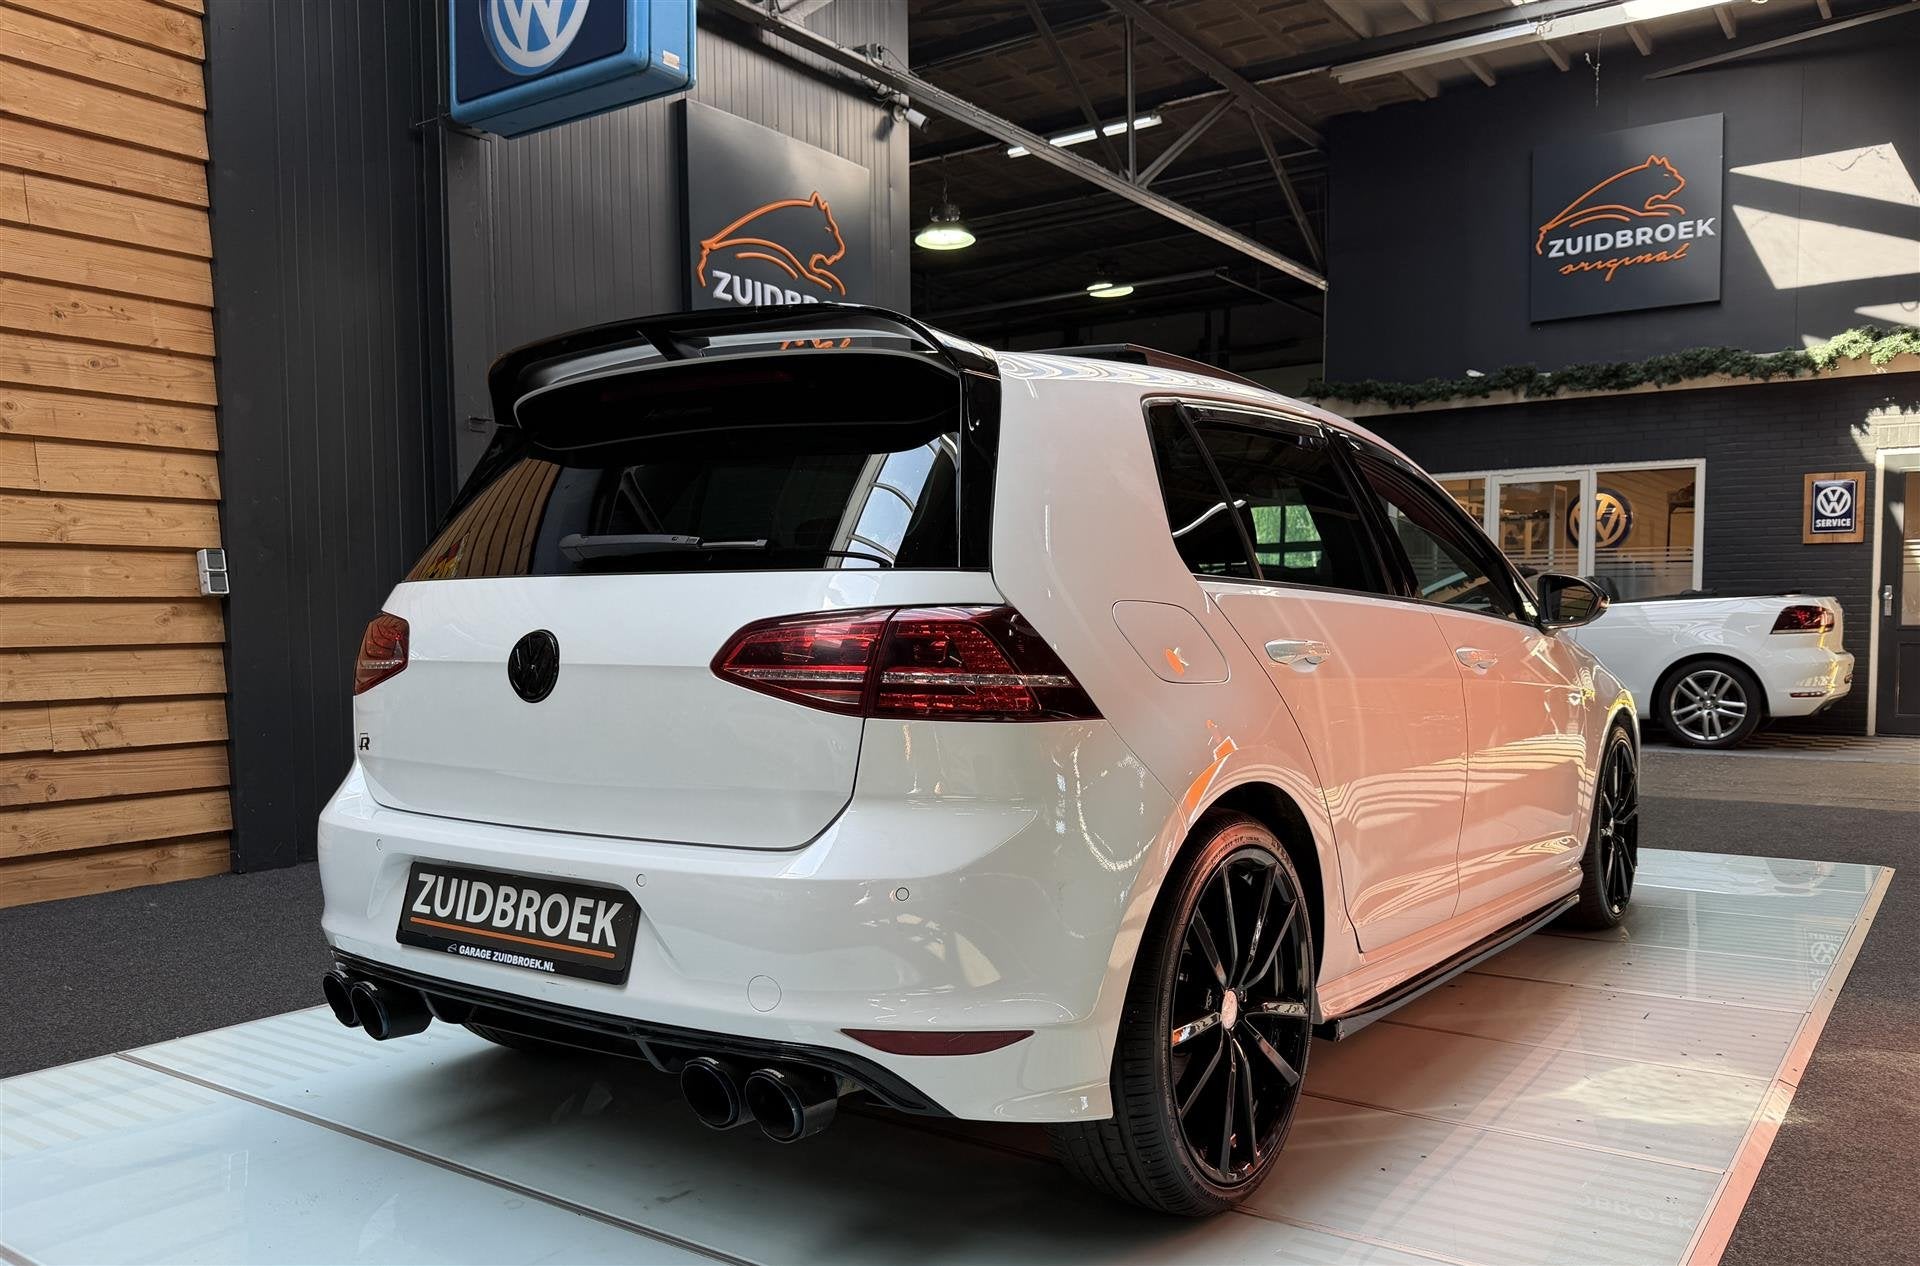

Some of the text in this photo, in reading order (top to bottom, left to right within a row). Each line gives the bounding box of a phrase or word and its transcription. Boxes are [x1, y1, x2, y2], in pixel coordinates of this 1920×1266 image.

[1547, 217, 1716, 259] ZUIDBROEK
[1559, 242, 1690, 282] original
[1815, 518, 1852, 528] SERVICE
[359, 733, 370, 751] R
[412, 872, 624, 947] ZUIDBROEK
[459, 945, 556, 972] GARAGE ZUIDBROEK.NL
